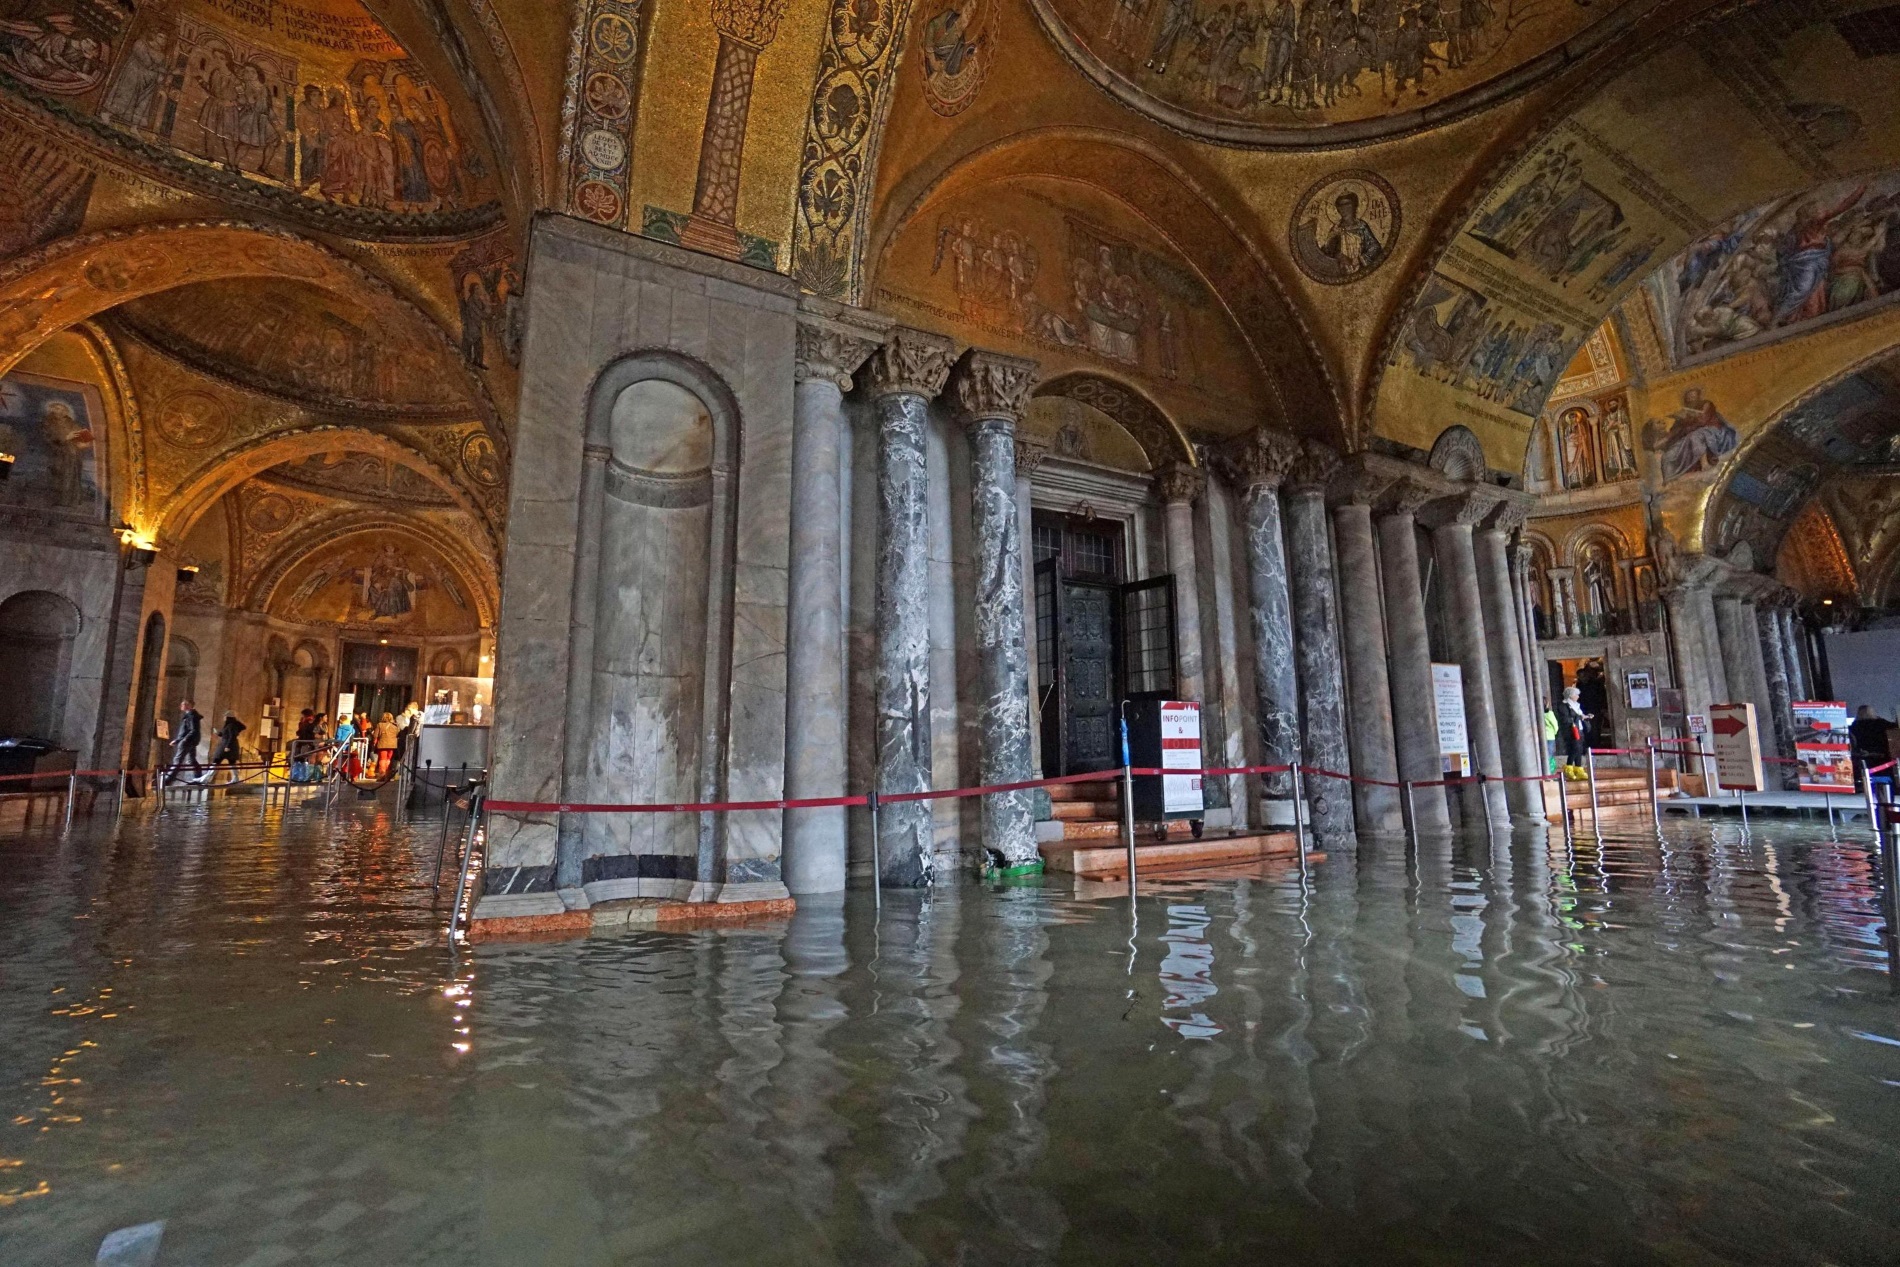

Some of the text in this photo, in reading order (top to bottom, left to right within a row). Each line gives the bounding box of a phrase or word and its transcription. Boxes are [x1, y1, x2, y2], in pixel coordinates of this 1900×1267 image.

[1162, 715, 1198, 723] INFOPOINT
[1178, 726, 1184, 734] &
[1163, 739, 1199, 749] TOUR
